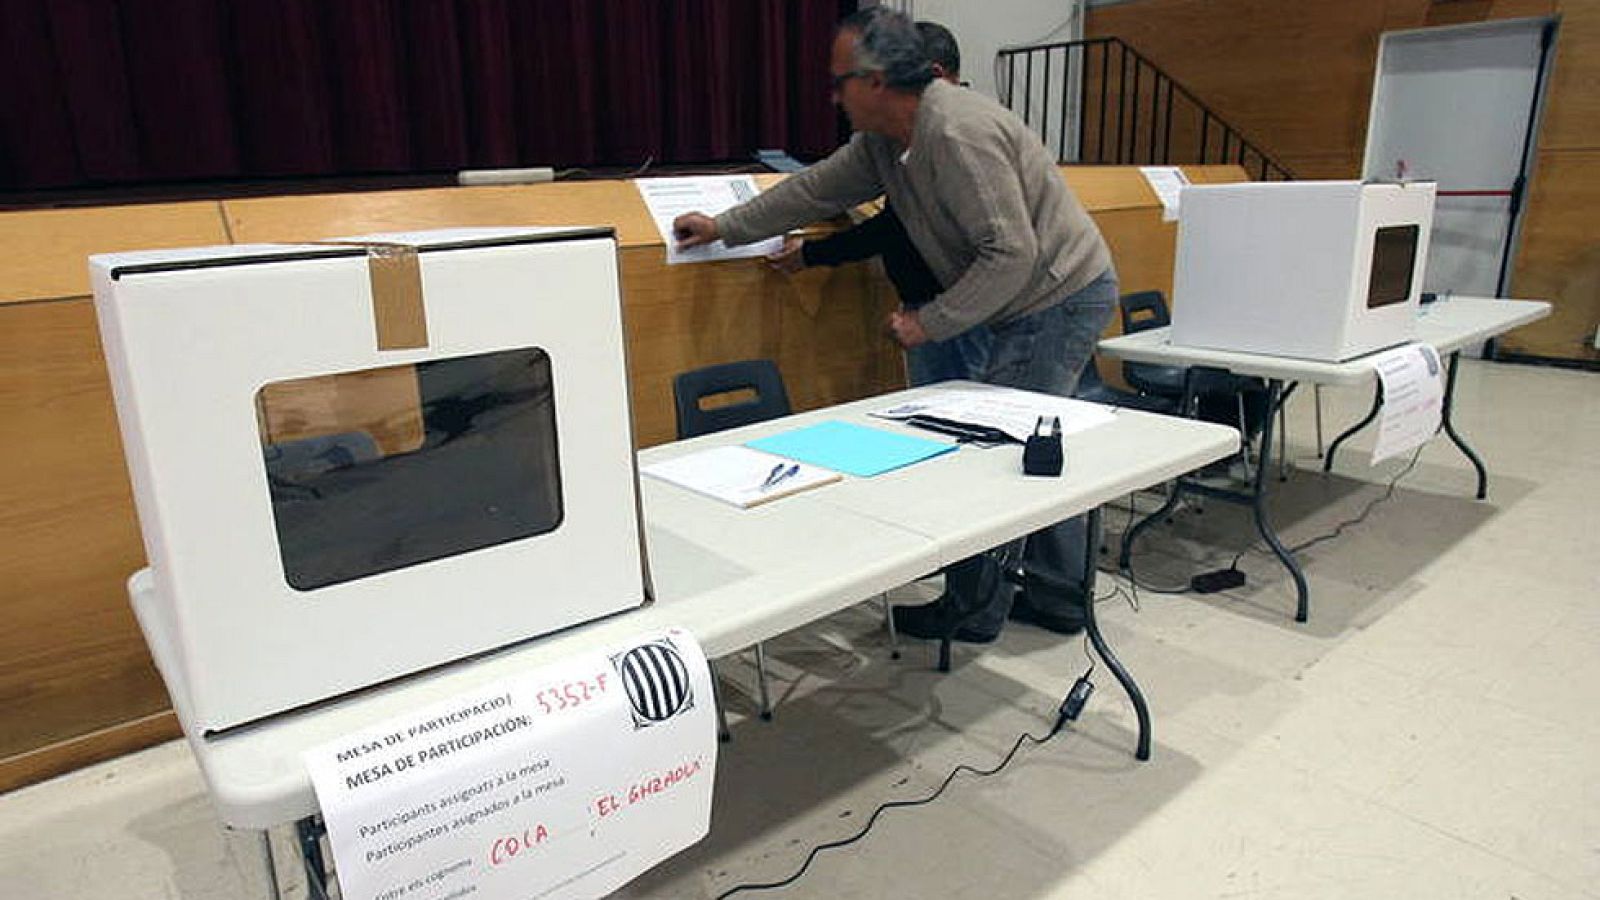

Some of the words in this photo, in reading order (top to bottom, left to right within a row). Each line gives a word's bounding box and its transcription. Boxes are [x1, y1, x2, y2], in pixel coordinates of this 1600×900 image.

[336, 740, 383, 763] MESA
[384, 732, 406, 747] DE
[345, 763, 393, 790] MESA
[394, 755, 417, 772] DE
[358, 804, 437, 839] Participants
[505, 770, 517, 781] la
[519, 759, 550, 777] mesa
[597, 794, 620, 816] EL
[366, 824, 450, 863] Participantes
[452, 800, 510, 830] asignados
[521, 787, 533, 800] la
[535, 776, 566, 795] mesa
